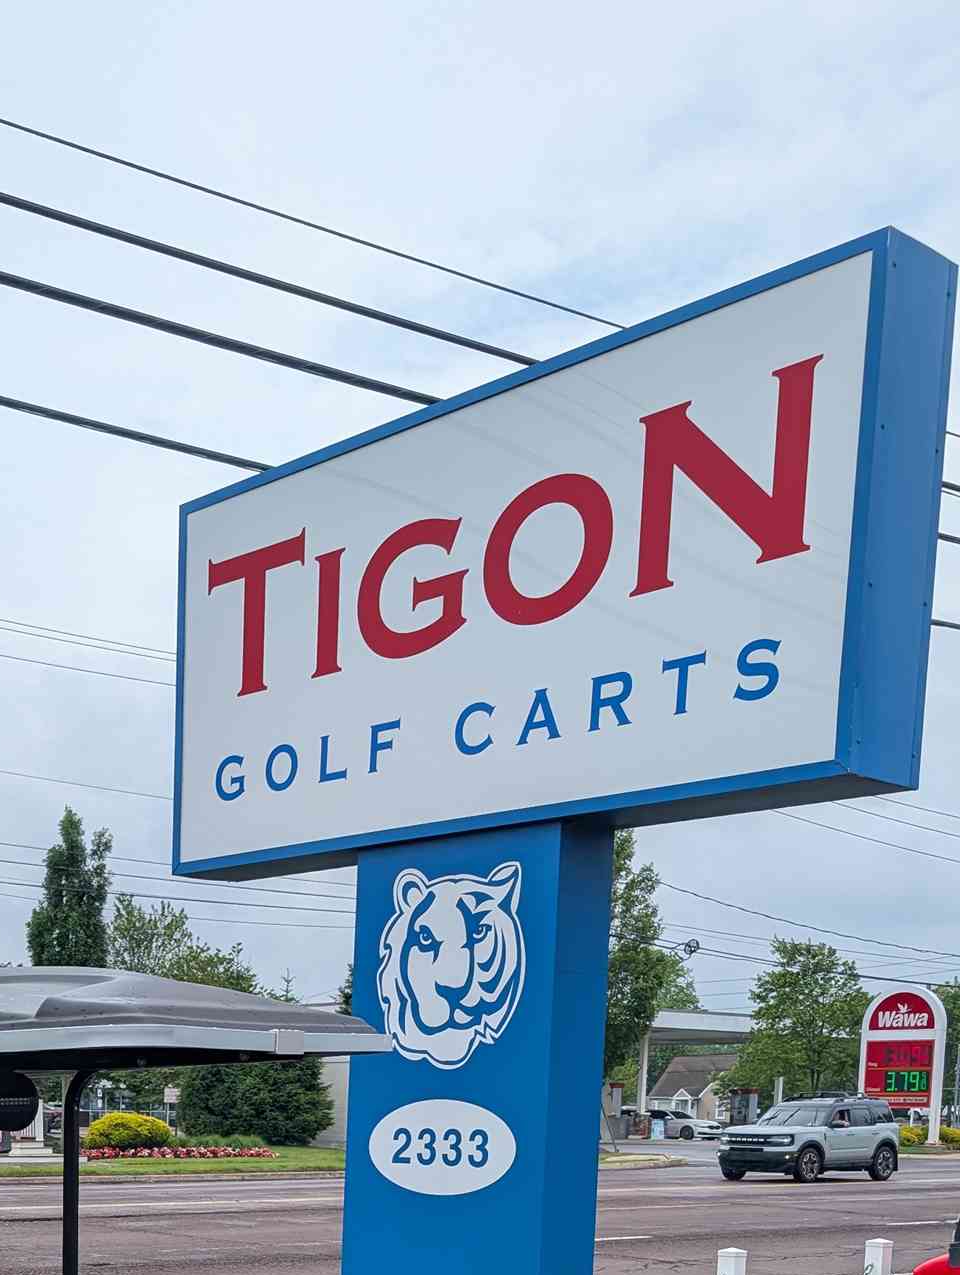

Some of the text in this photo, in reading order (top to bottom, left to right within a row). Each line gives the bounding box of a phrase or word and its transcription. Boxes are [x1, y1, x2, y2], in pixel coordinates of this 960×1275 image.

[207, 355, 822, 698] TIGON
[214, 638, 781, 801] GOLF CARTS
[877, 1010, 929, 1028] Wawa
[391, 1127, 490, 1168] 2333
